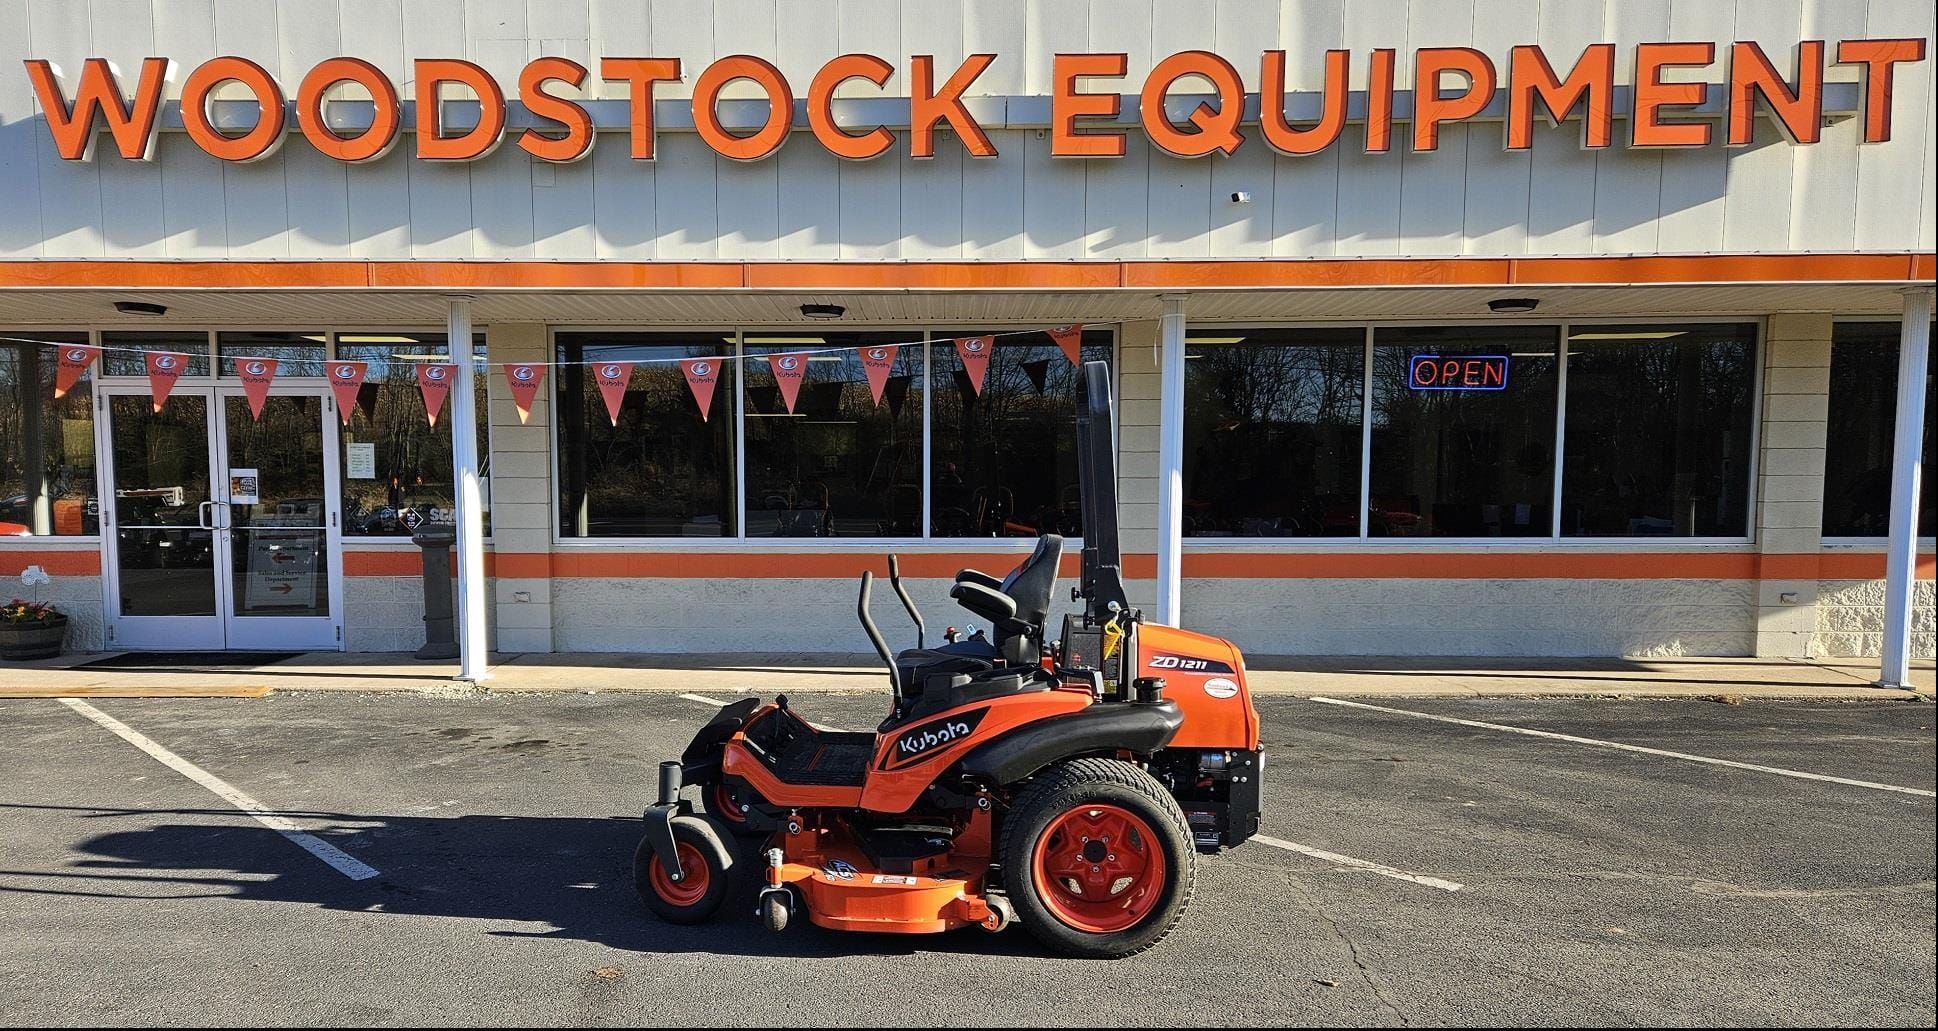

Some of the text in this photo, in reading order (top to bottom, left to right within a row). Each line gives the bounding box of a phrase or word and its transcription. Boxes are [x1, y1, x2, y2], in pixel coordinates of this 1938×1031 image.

[25, 37, 1928, 161] WOODSTOCK EQUIPMENT
[776, 371, 802, 379] Kubota
[1415, 361, 1503, 385] OPEN
[900, 722, 969, 753] Kubota
